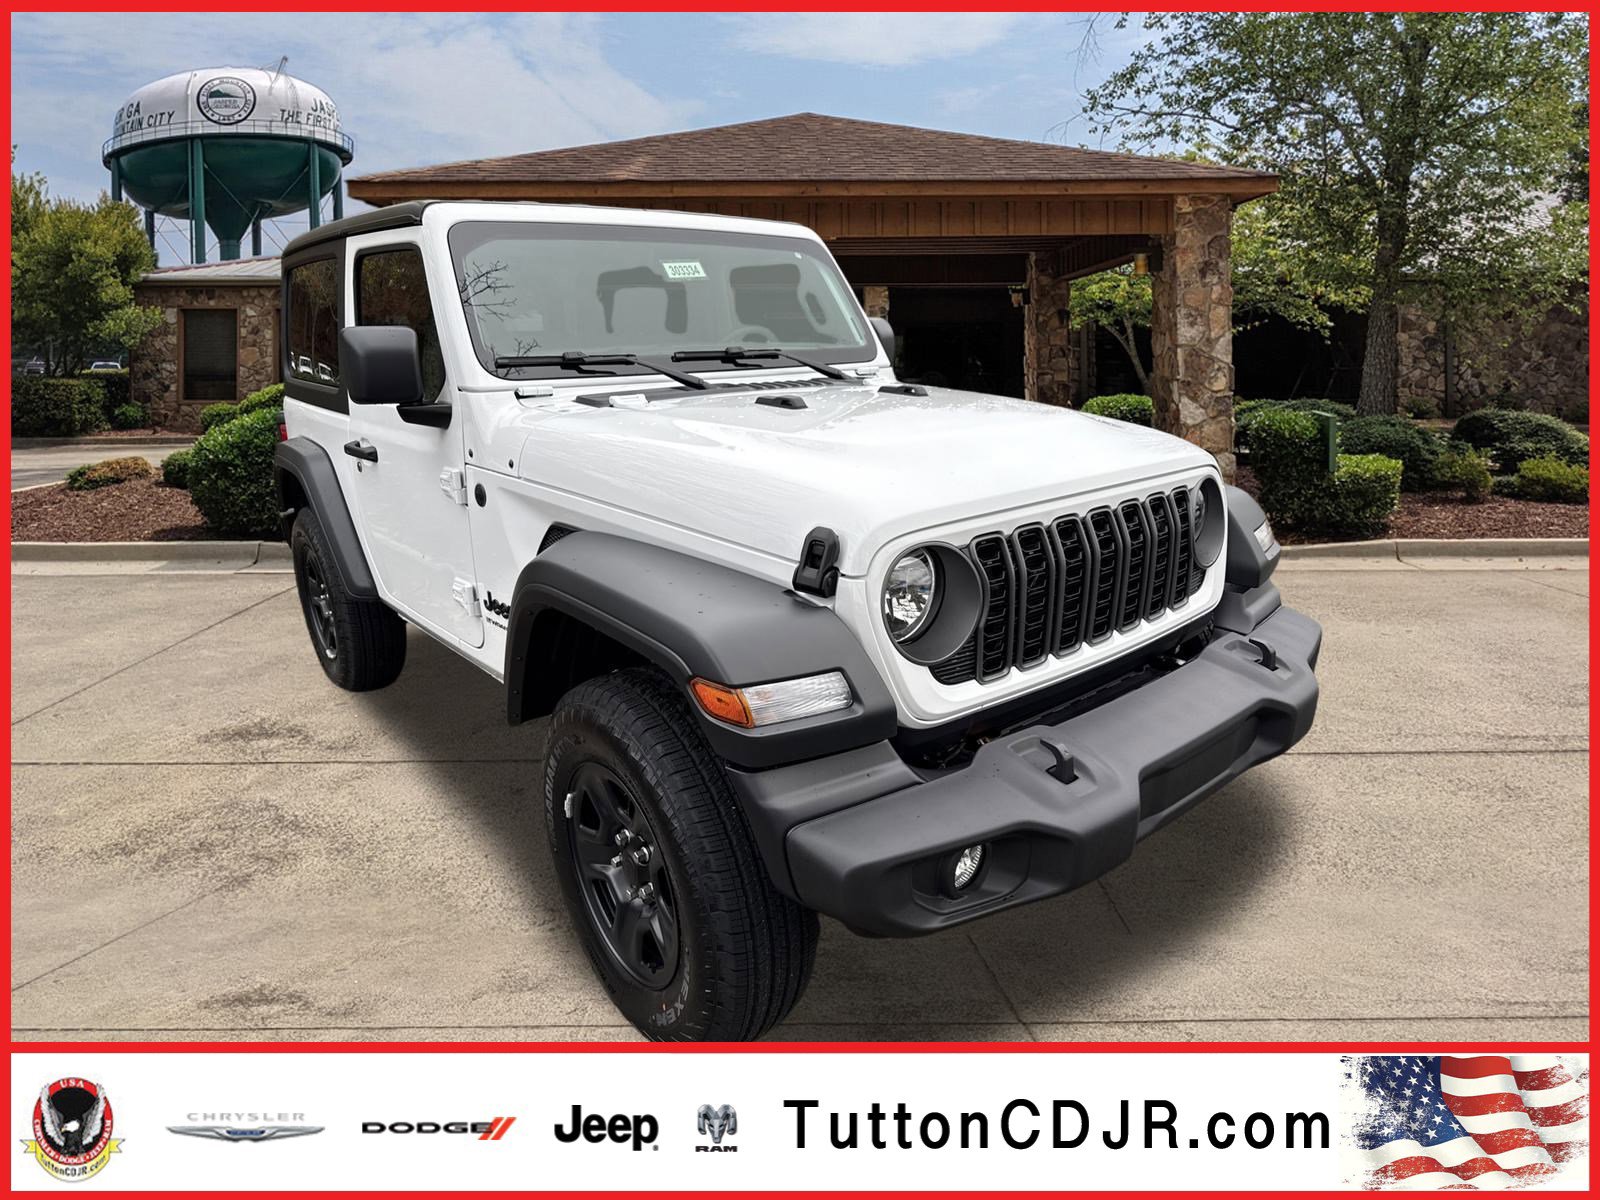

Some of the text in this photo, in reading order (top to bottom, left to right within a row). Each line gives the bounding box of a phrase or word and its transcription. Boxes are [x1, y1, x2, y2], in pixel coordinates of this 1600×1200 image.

[126, 101, 141, 119] GA
[280, 109, 302, 124] THE
[147, 110, 176, 127] CITY
[668, 264, 701, 276] 303334
